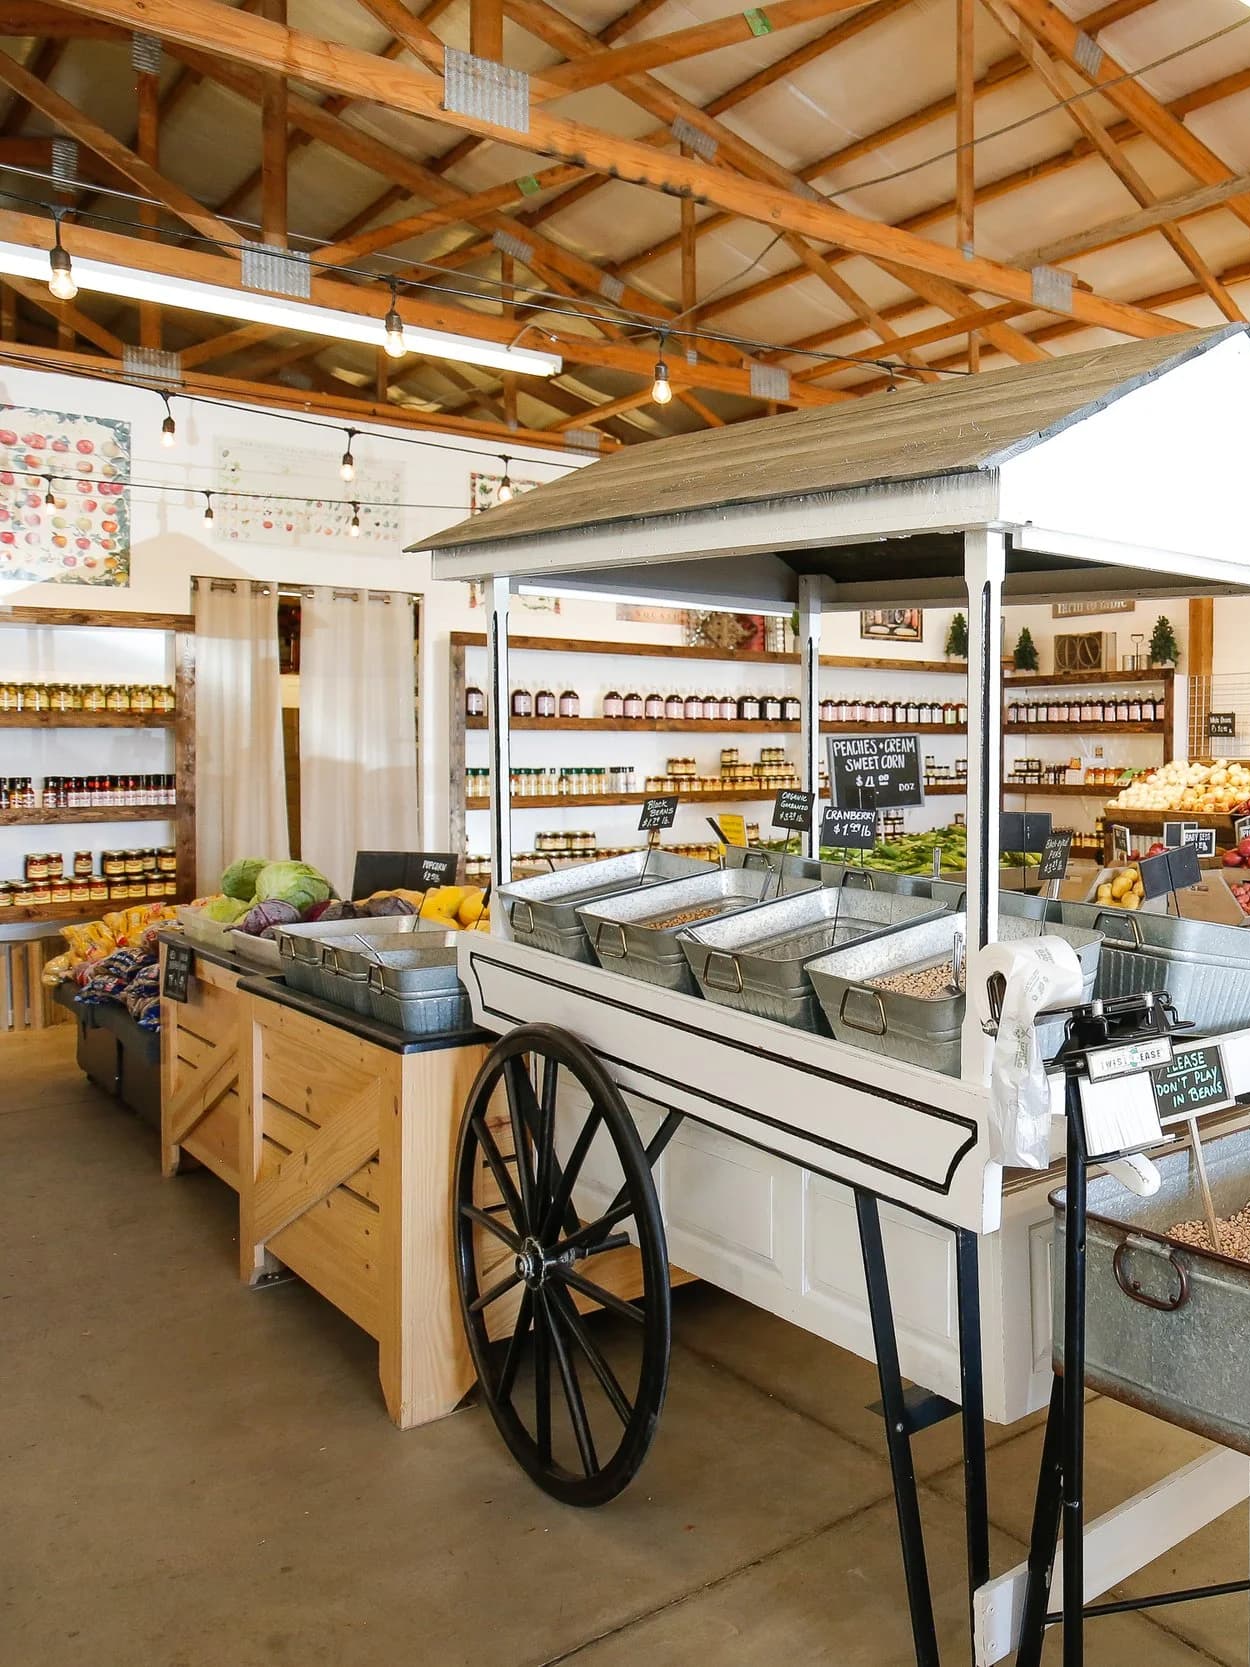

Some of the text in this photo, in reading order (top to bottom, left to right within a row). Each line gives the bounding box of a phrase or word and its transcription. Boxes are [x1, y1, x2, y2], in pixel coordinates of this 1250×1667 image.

[833, 739, 877, 757] PEACHES
[884, 738, 916, 753] CREAM
[845, 754, 905, 772] SWEET CORN
[898, 783, 915, 791] DOZ
[647, 800, 668, 810] Black
[825, 809, 876, 822] CRANBERRY
[861, 825, 871, 837] lb
[422, 860, 448, 871] POPCORN
[1140, 1050, 1161, 1061] EASE
[1156, 1065, 1217, 1097] DON'T PLAY
[1173, 1081, 1223, 1107] IN BEANS
